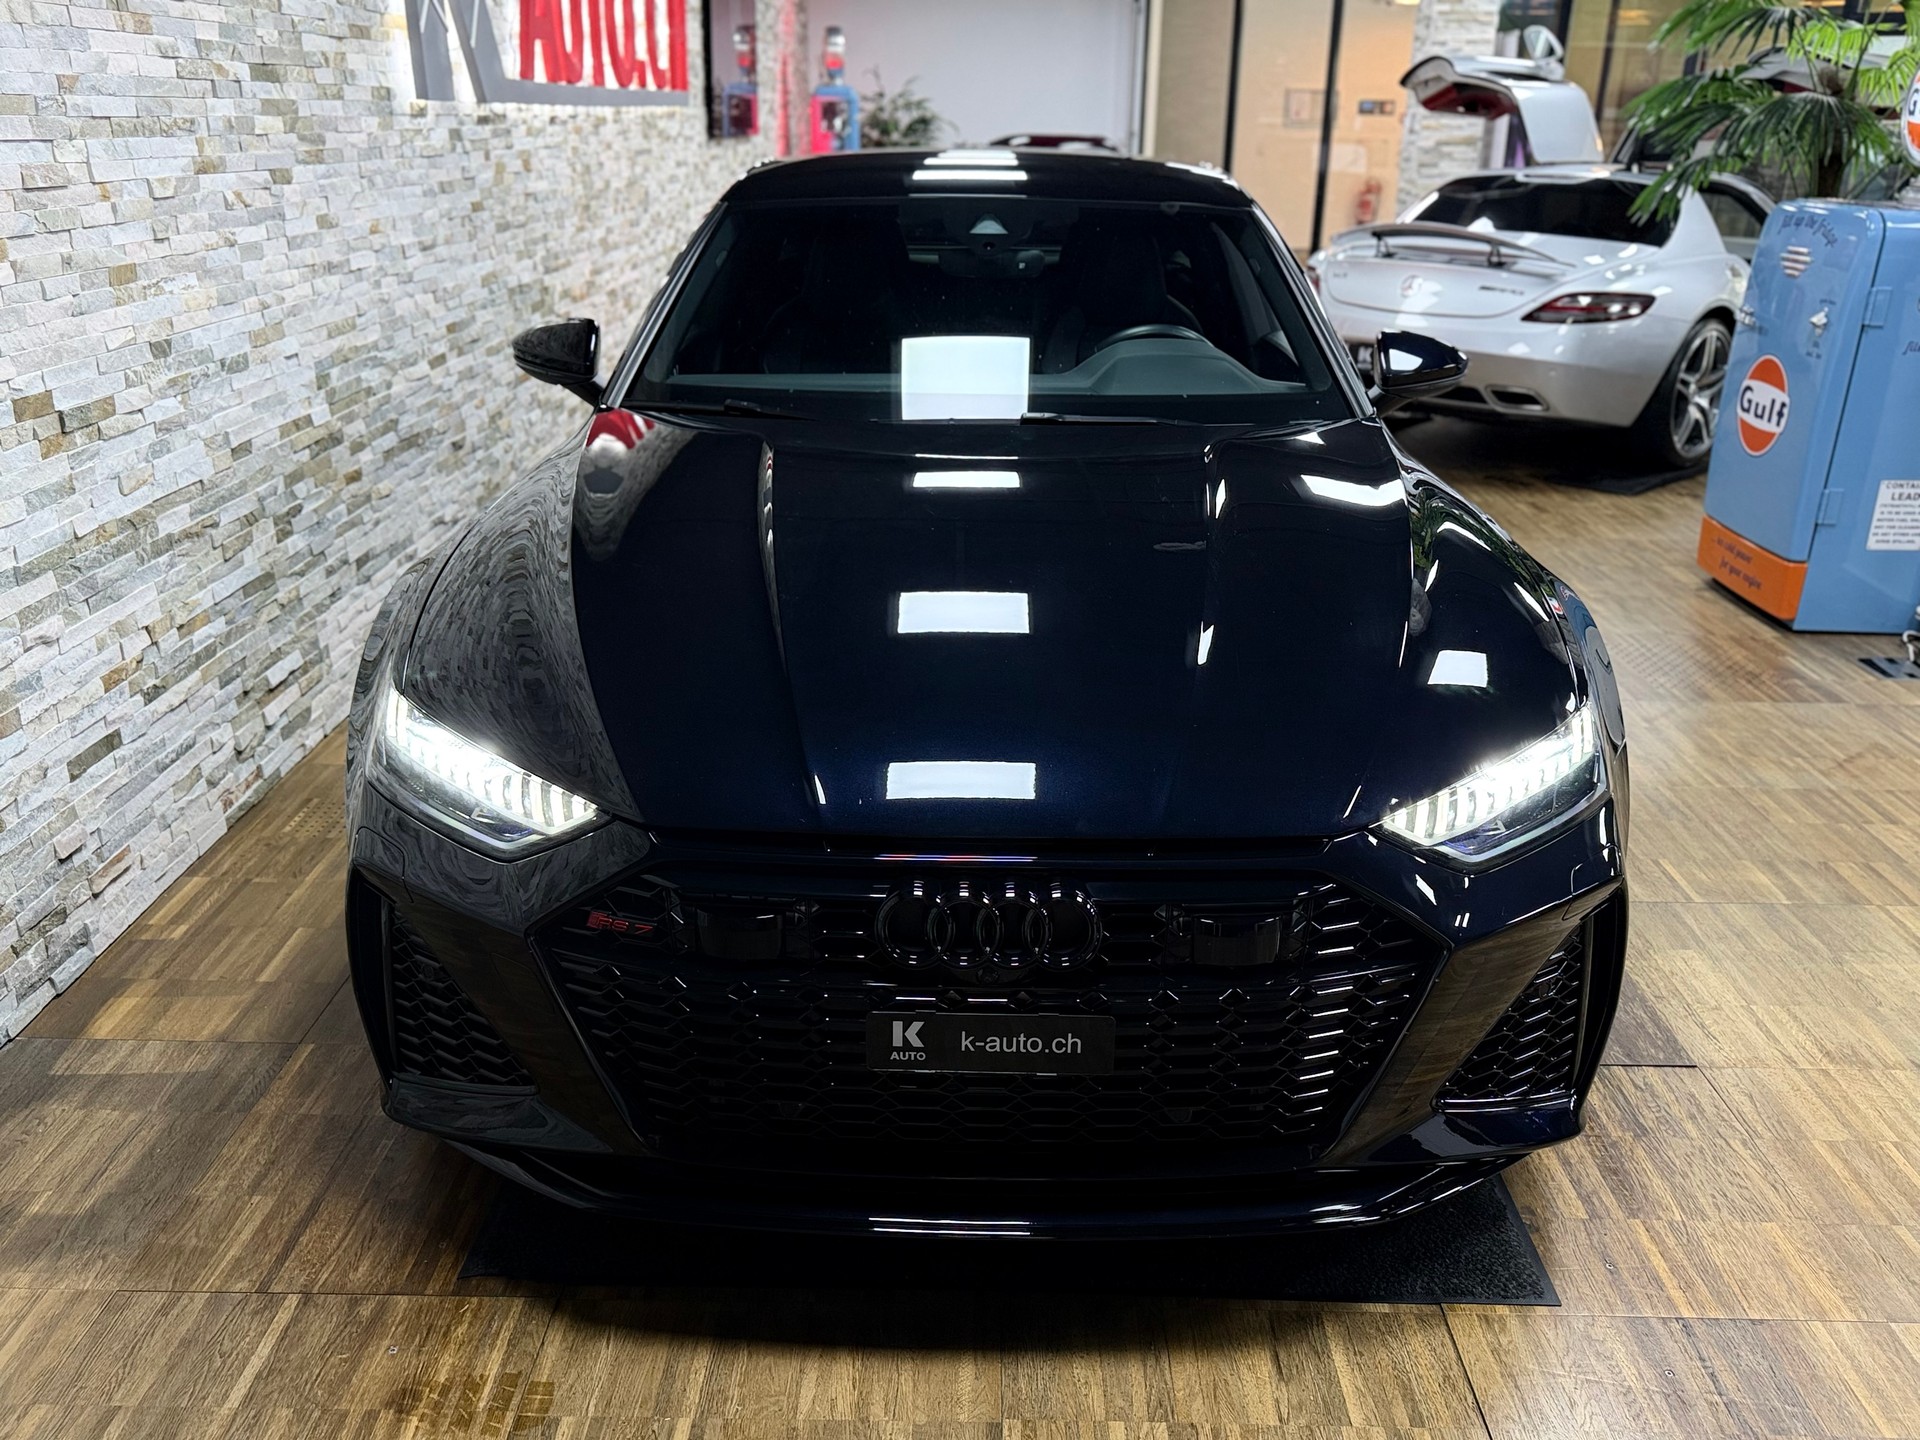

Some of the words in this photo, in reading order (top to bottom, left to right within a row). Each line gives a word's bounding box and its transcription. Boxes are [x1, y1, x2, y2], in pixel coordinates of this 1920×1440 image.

[1740, 385, 1787, 427] Gulf
[892, 1020, 925, 1048] K
[961, 1030, 1082, 1054] k-auto.ch
[890, 1051, 926, 1061] AUTO
